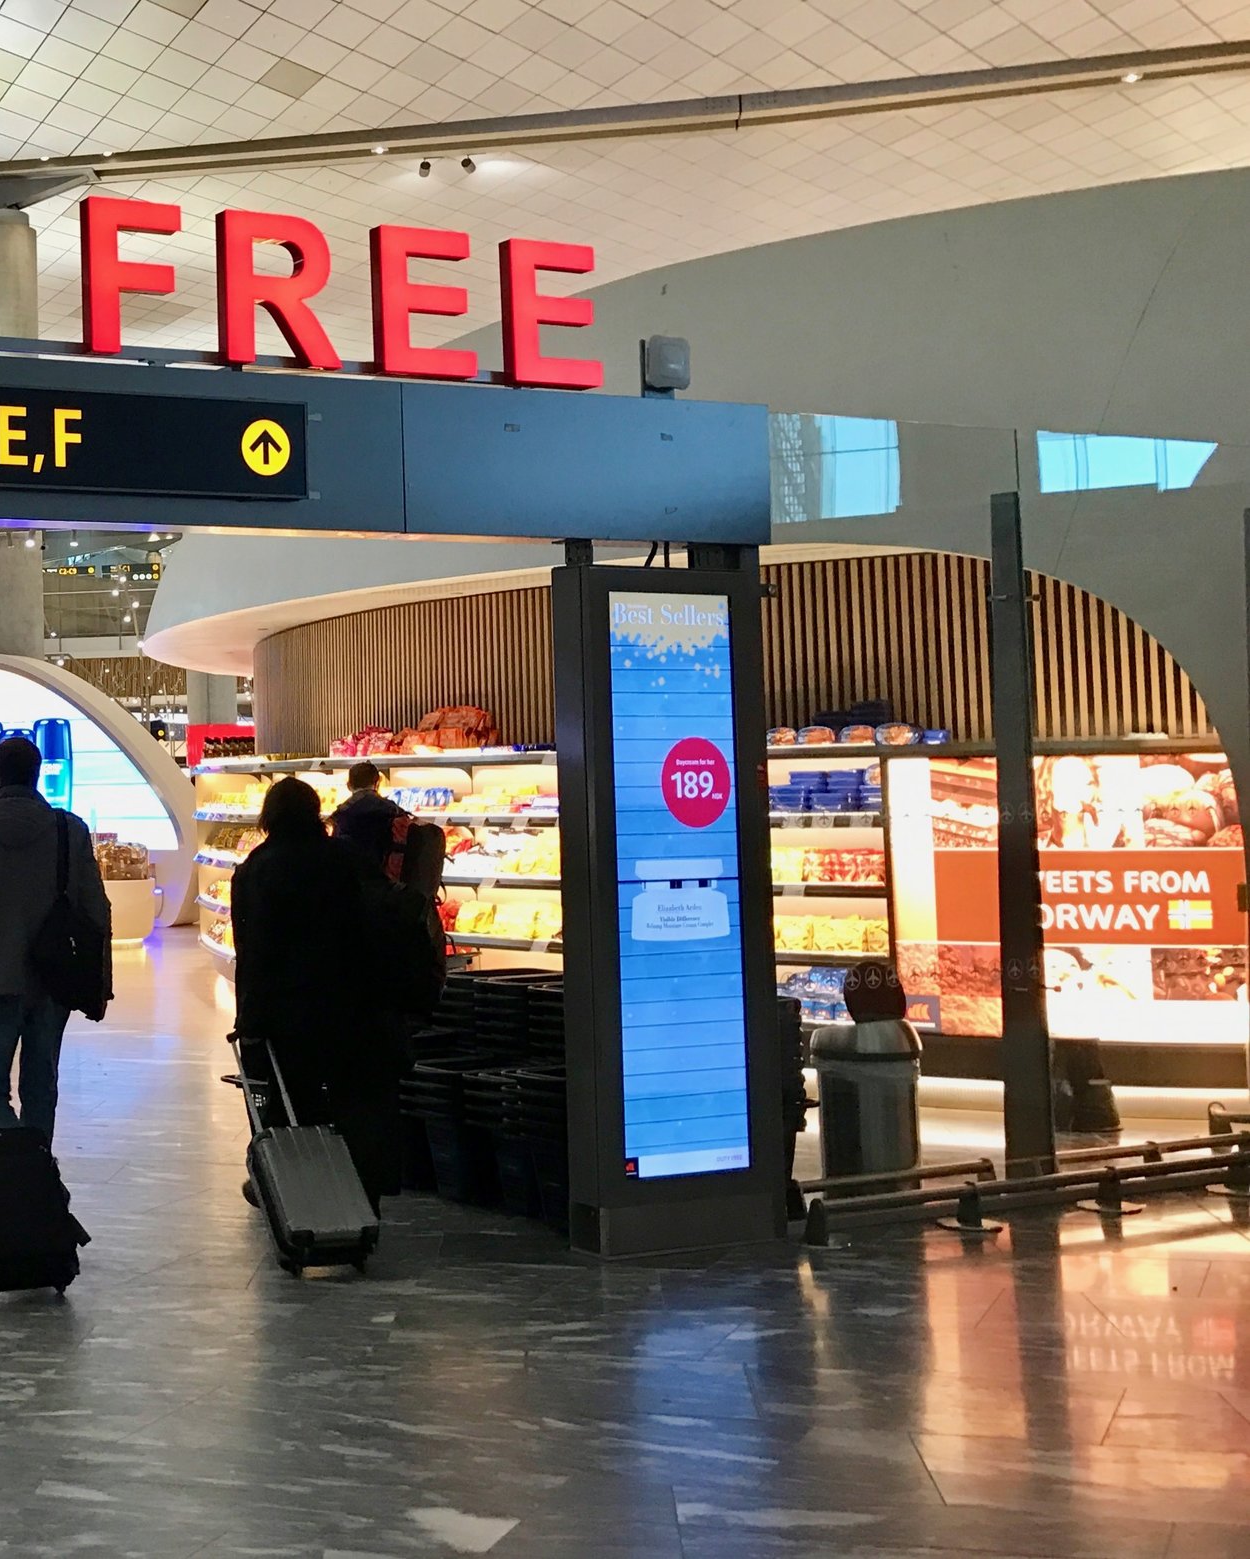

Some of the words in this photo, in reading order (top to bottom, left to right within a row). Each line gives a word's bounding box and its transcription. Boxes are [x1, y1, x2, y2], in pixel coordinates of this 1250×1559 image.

[80, 196, 604, 389] FREE
[614, 602, 654, 625] Best
[660, 604, 725, 626] Sellers
[670, 771, 714, 798] 189
[1038, 870, 1114, 893] EETS
[1123, 870, 1210, 893] FROM
[1040, 903, 1160, 930] ORWAY
